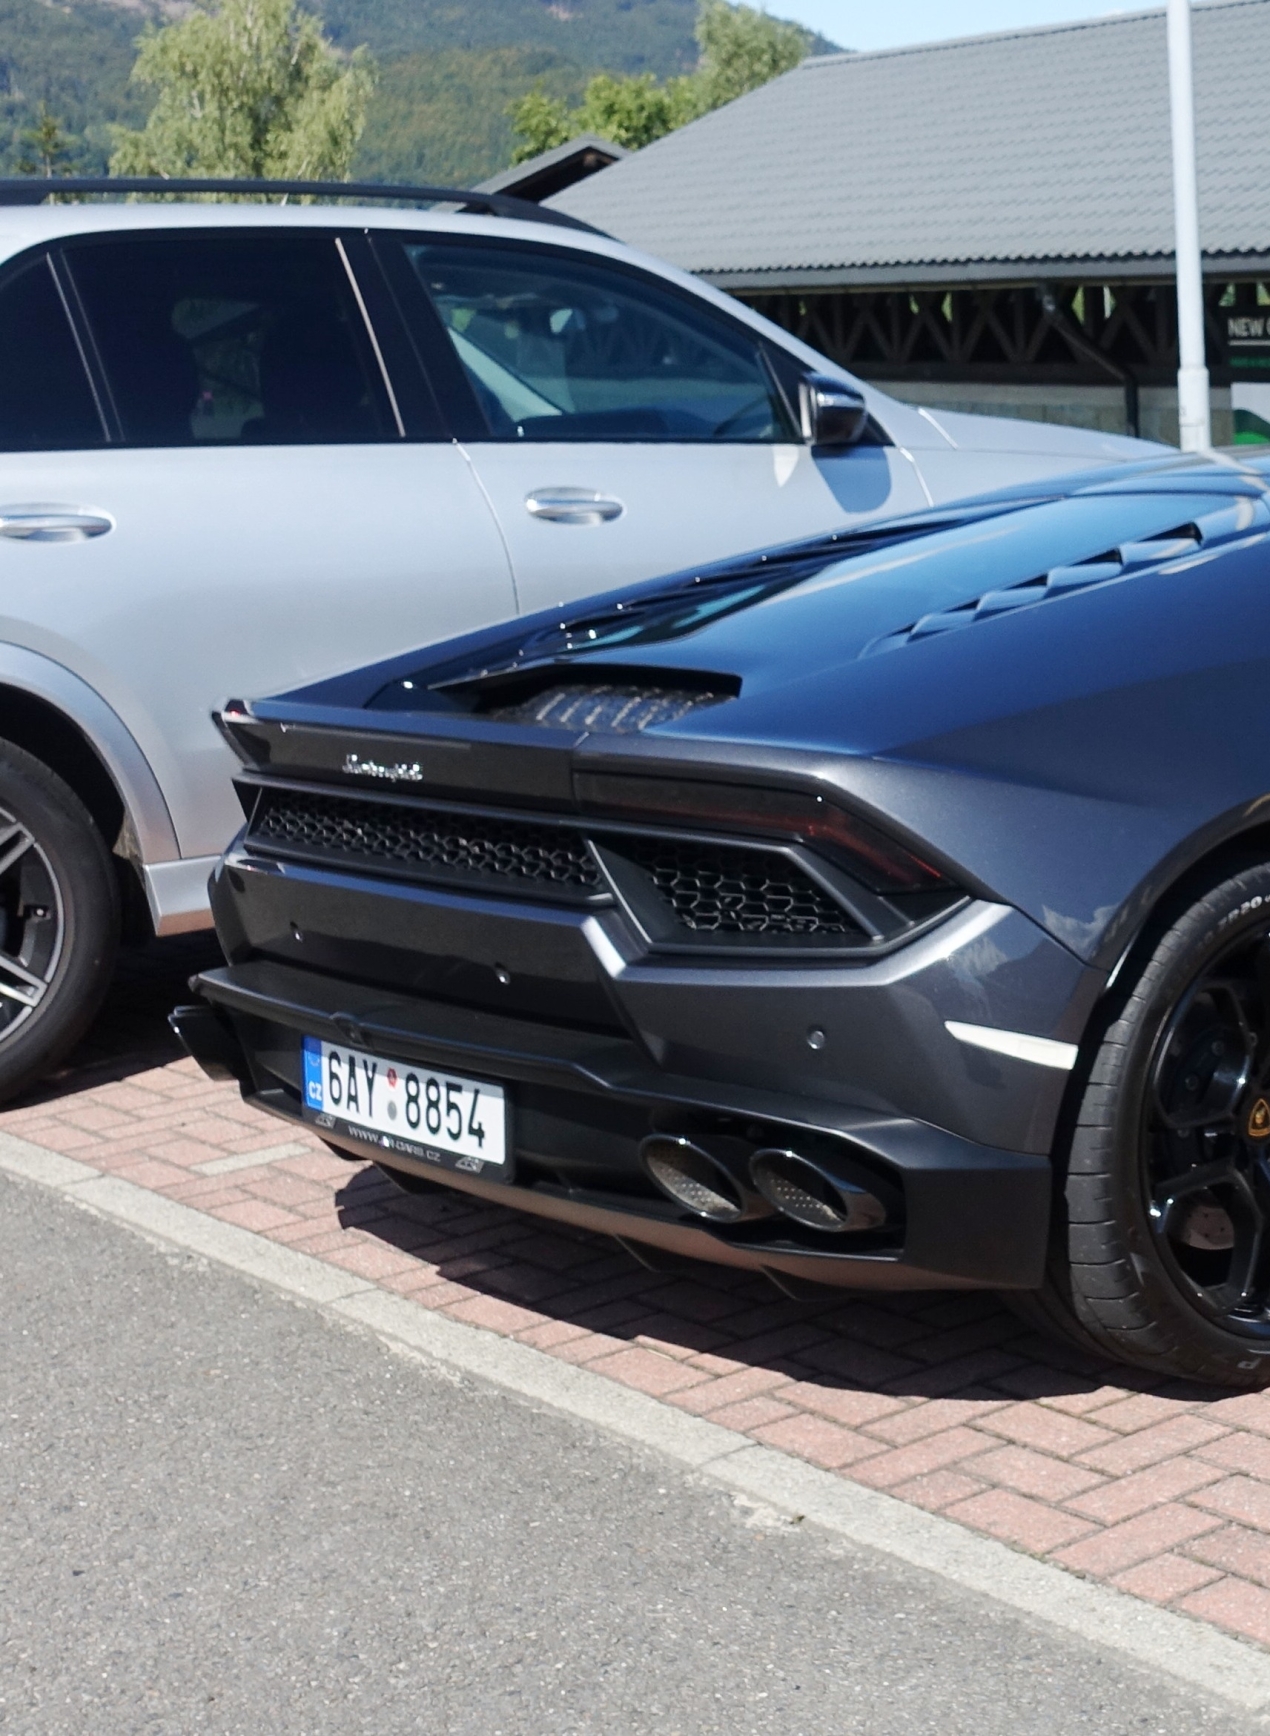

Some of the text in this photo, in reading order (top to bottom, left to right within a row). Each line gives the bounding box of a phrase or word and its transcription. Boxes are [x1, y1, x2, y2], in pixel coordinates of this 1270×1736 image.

[1227, 316, 1264, 337] NEW
[309, 1081, 322, 1101] CZ
[329, 1052, 485, 1147] 6AY 8854
